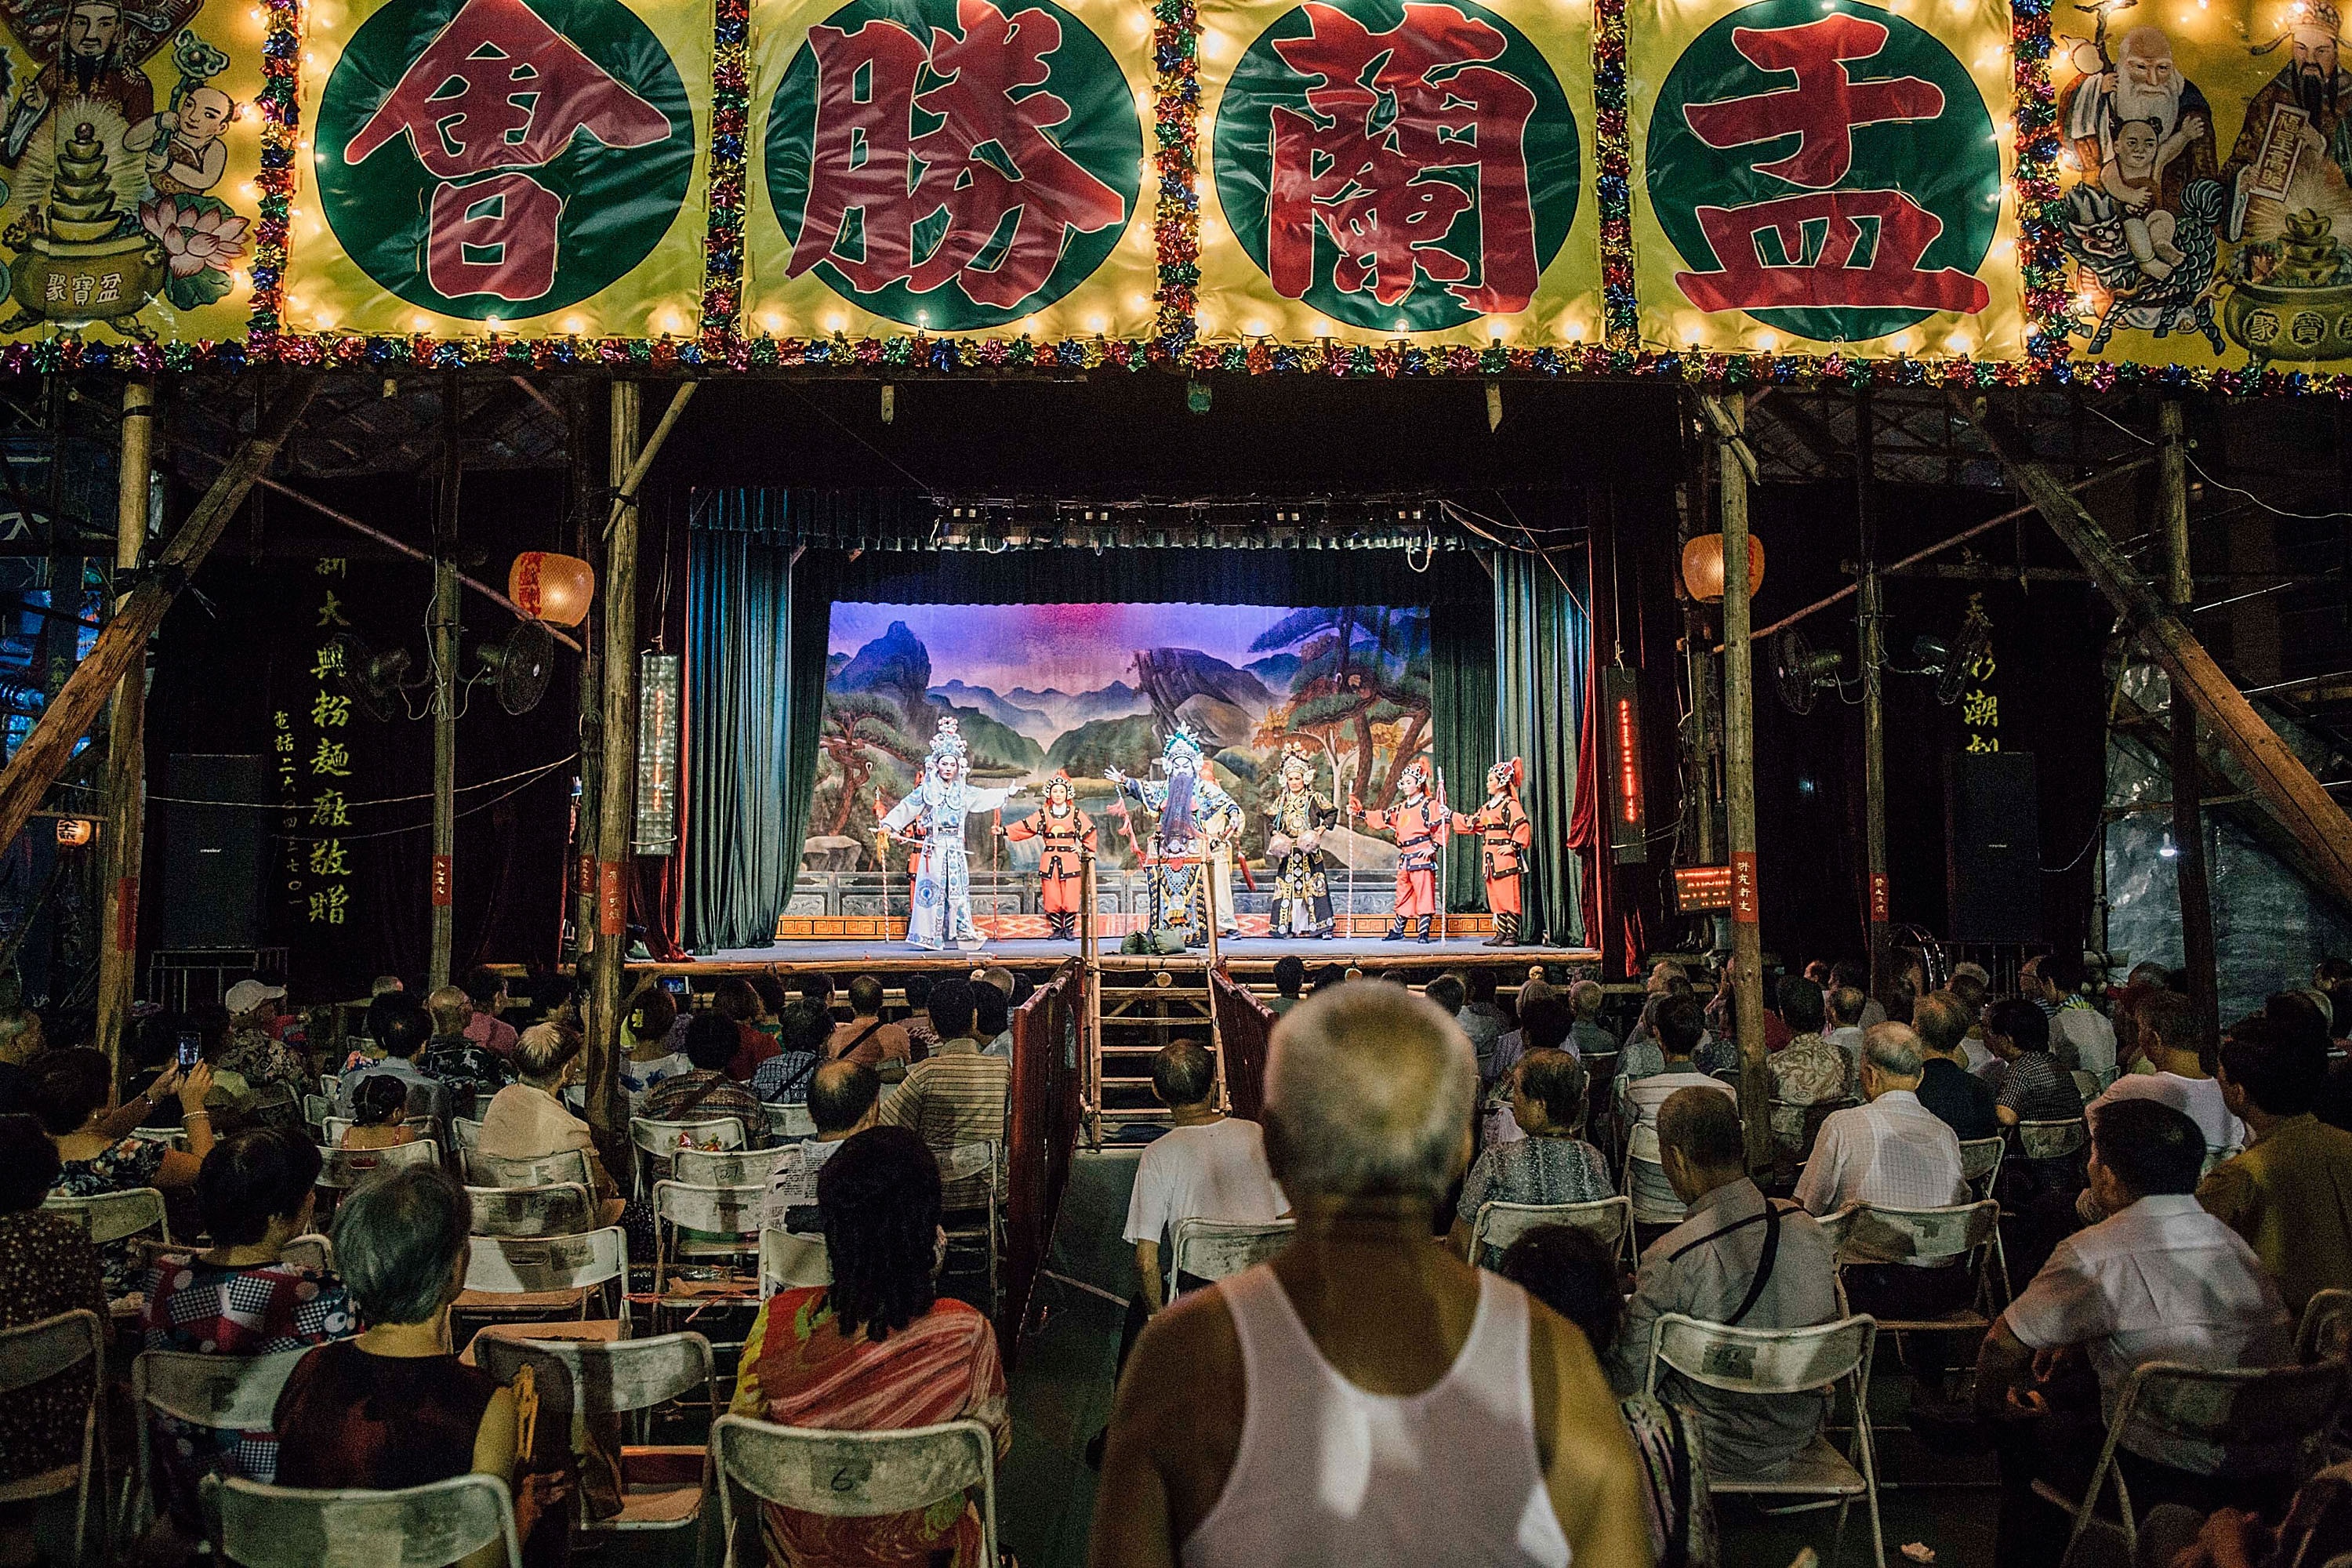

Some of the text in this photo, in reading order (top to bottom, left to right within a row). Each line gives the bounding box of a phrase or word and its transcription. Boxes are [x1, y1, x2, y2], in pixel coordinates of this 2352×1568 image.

[46, 272, 123, 307] 聚寶盆
[830, 1467, 854, 1491] 6
